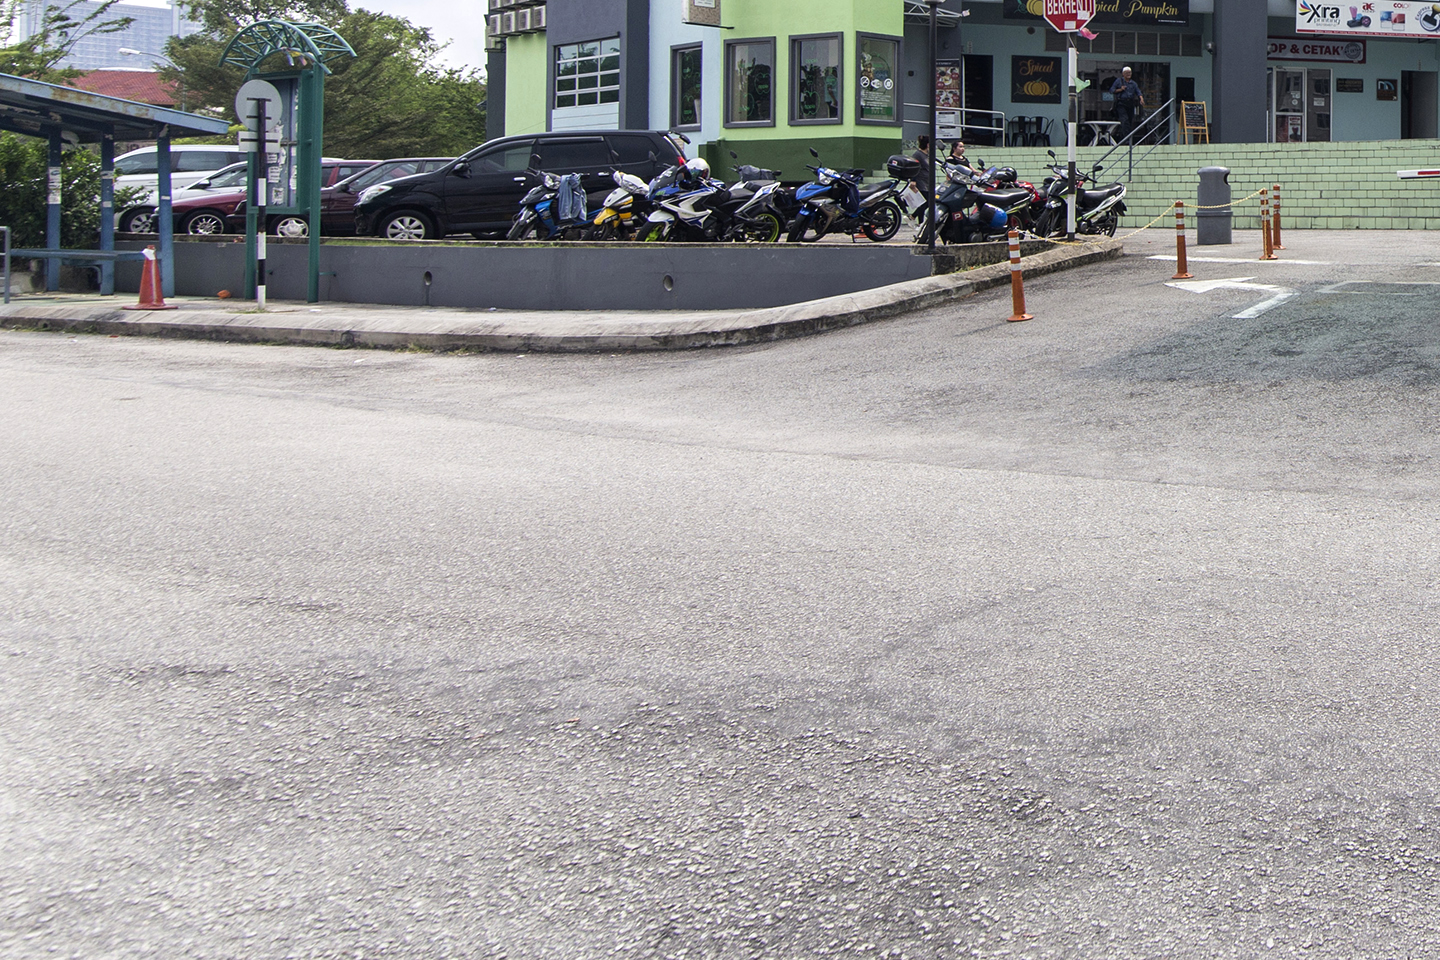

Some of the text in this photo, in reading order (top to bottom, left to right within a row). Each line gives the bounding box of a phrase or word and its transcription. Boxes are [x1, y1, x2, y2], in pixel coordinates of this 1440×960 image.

[1094, 0, 1179, 19] piced Pumpkin
[1289, 44, 1300, 54] &
[1019, 58, 1055, 76] Spiced
